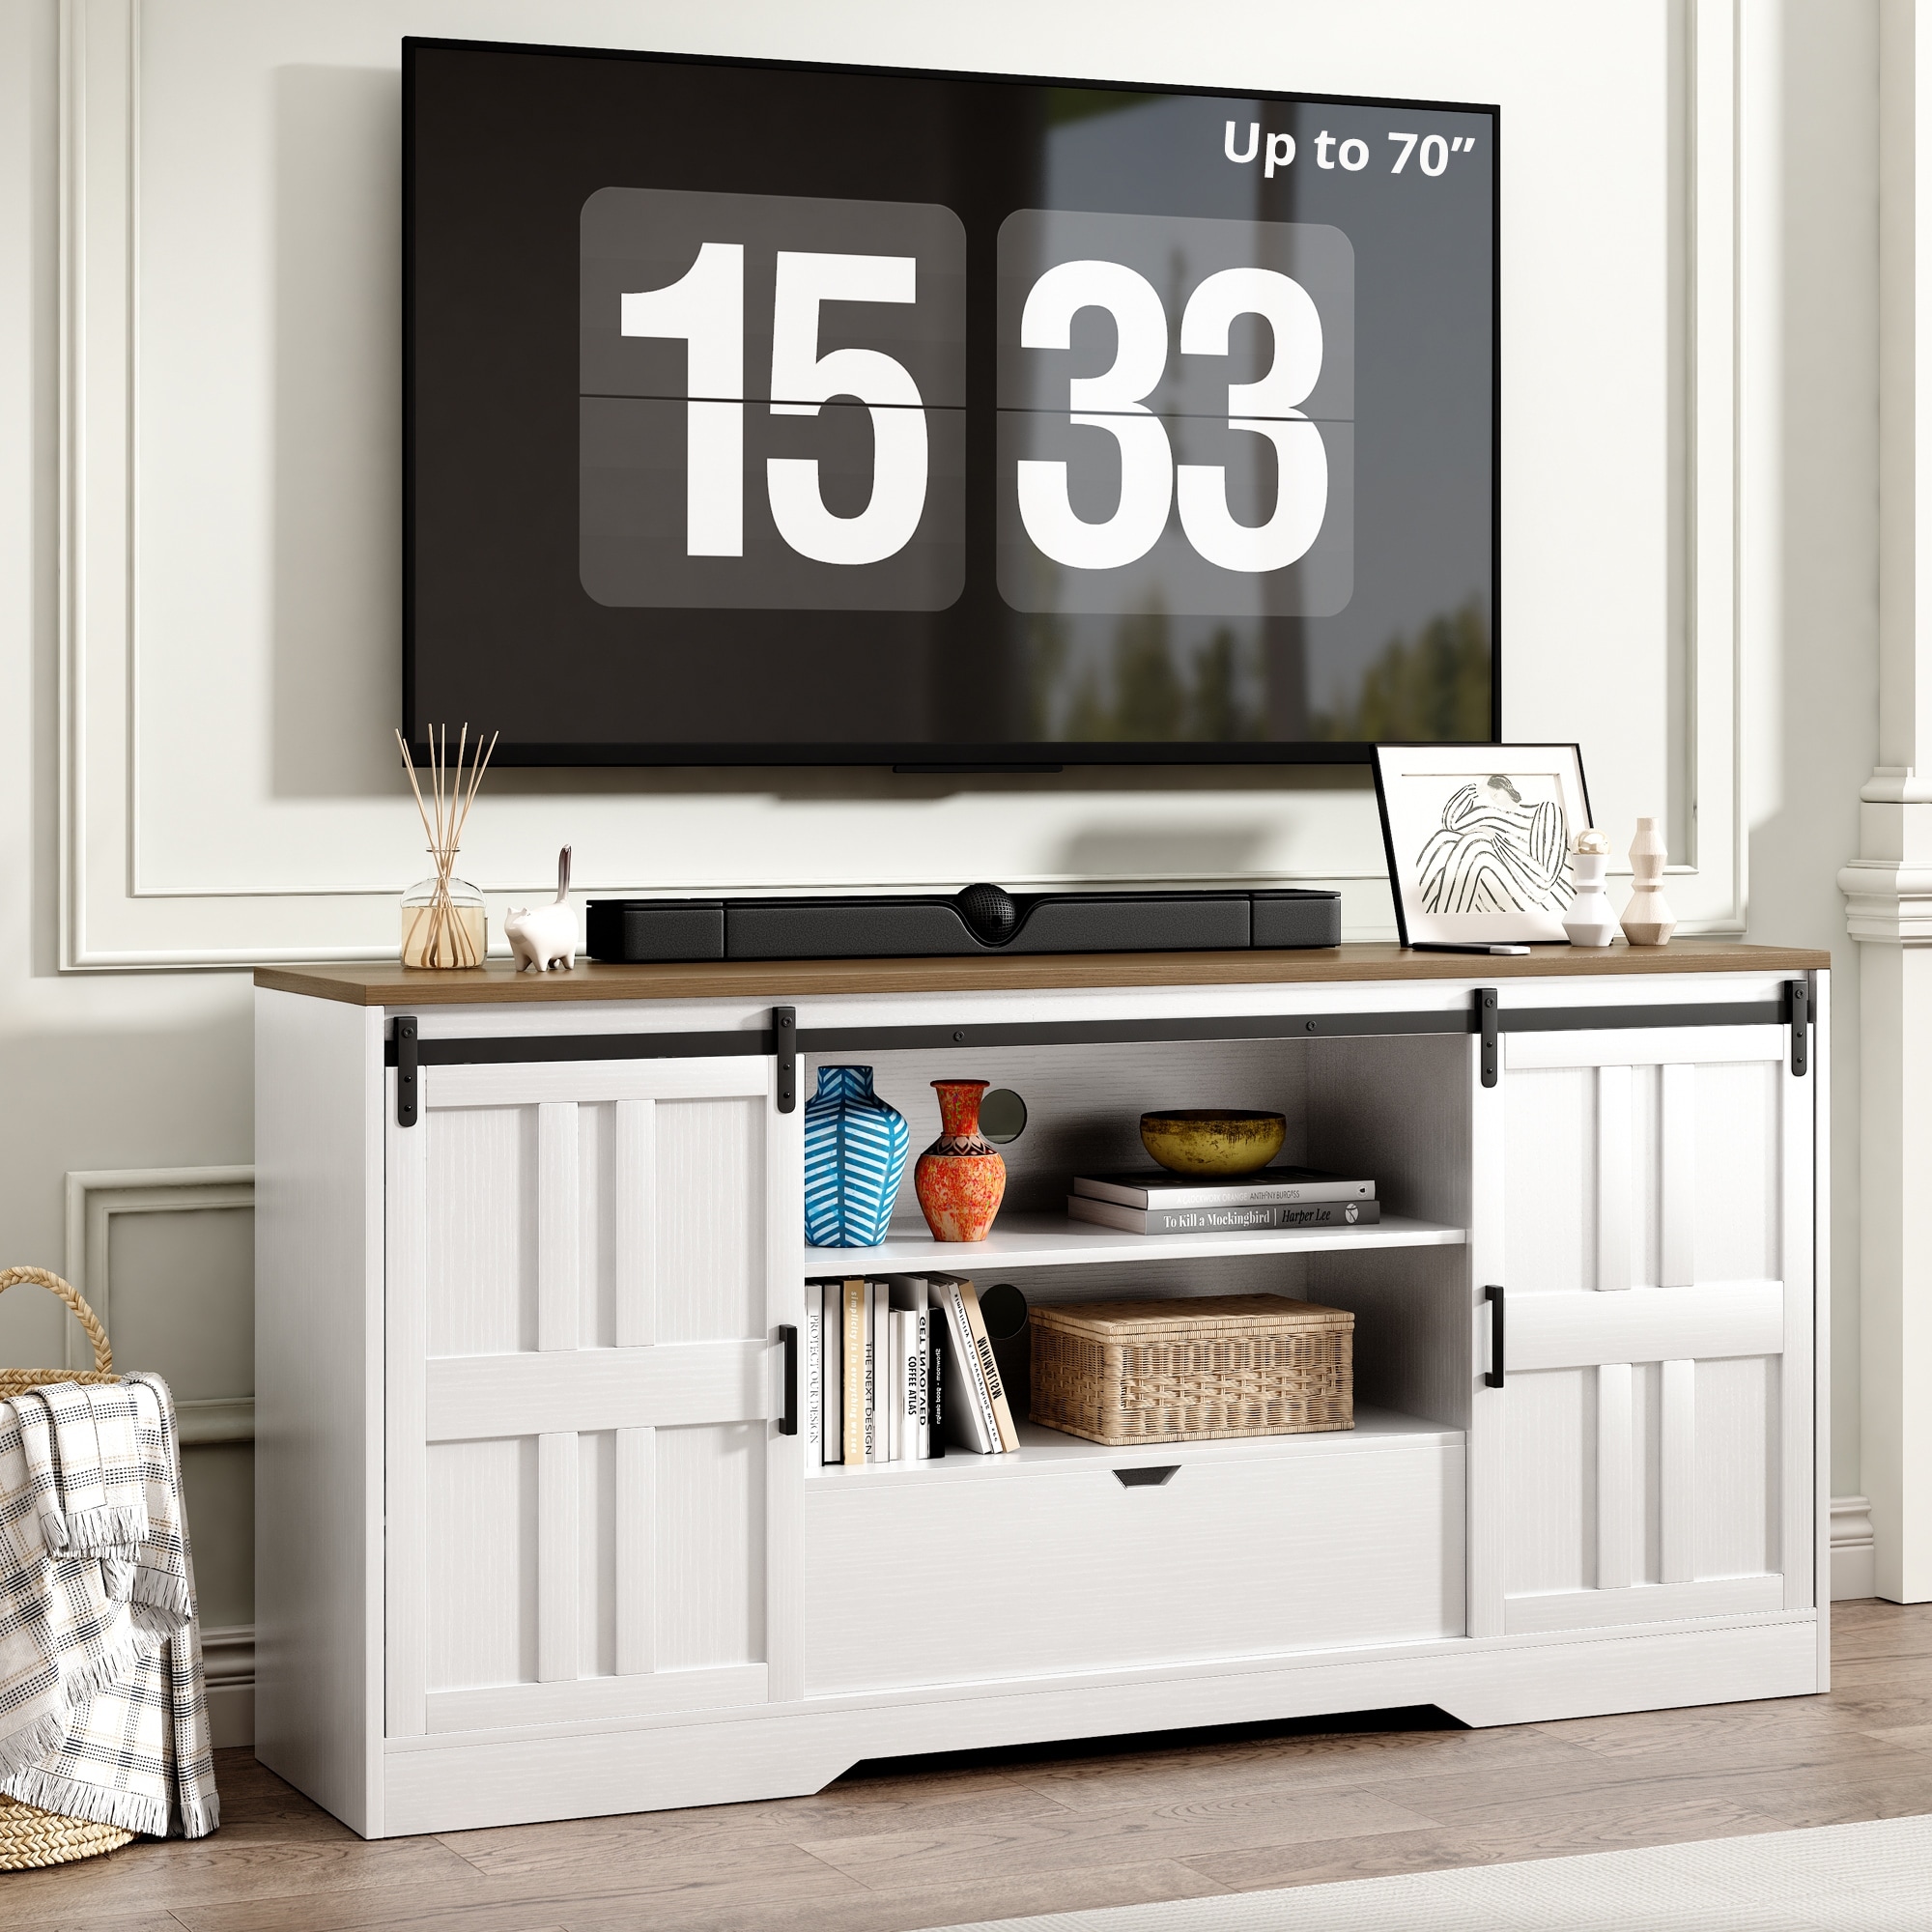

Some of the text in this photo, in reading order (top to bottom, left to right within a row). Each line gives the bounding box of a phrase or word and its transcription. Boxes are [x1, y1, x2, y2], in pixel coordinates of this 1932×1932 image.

[1224, 121, 1295, 178] Up
[1314, 130, 1369, 171] to
[620, 242, 1328, 573] 15 33
[1163, 1208, 1331, 1228] To Kill a Mockingbird Harper Lee
[1222, 1192, 1248, 1202] ORANGE
[849, 1291, 859, 1340] simplicity
[850, 1343, 859, 1351] is
[850, 1354, 859, 1363] in
[810, 1315, 819, 1444] PROTECT OUR DESIGN
[849, 1367, 859, 1418] everything
[908, 1356, 917, 1415] COFFEE ATLAS
[850, 1421, 857, 1435] we
